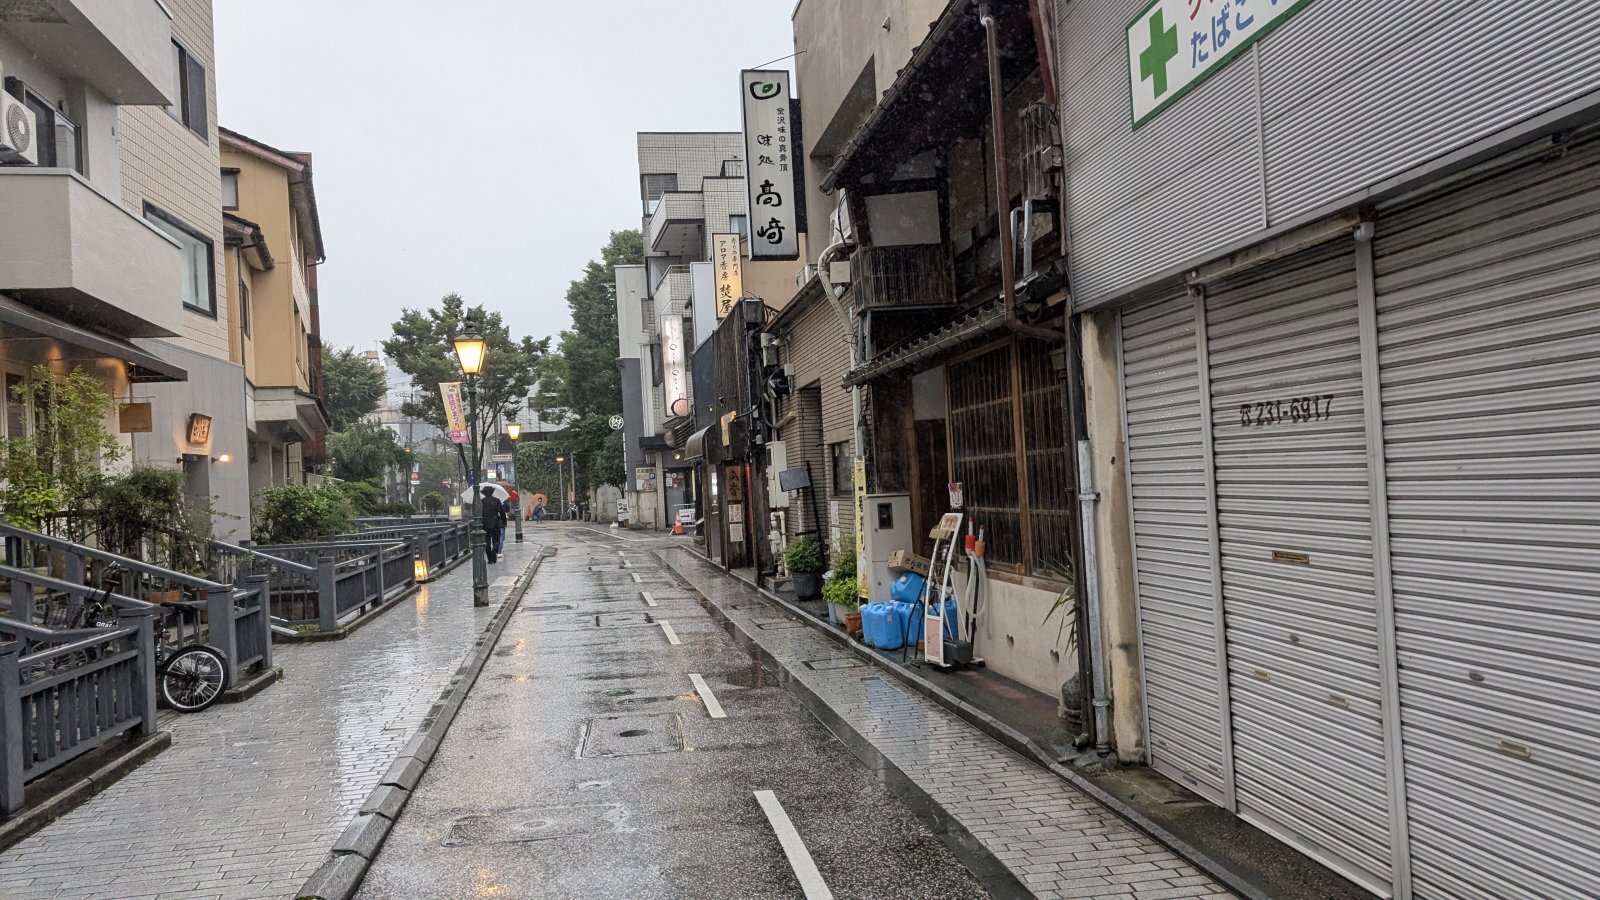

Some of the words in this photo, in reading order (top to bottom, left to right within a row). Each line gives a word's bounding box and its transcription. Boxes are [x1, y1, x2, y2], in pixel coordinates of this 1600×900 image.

[1190, 0, 1278, 69] たばこ
[776, 106, 789, 172] 金沢味の真骨頂
